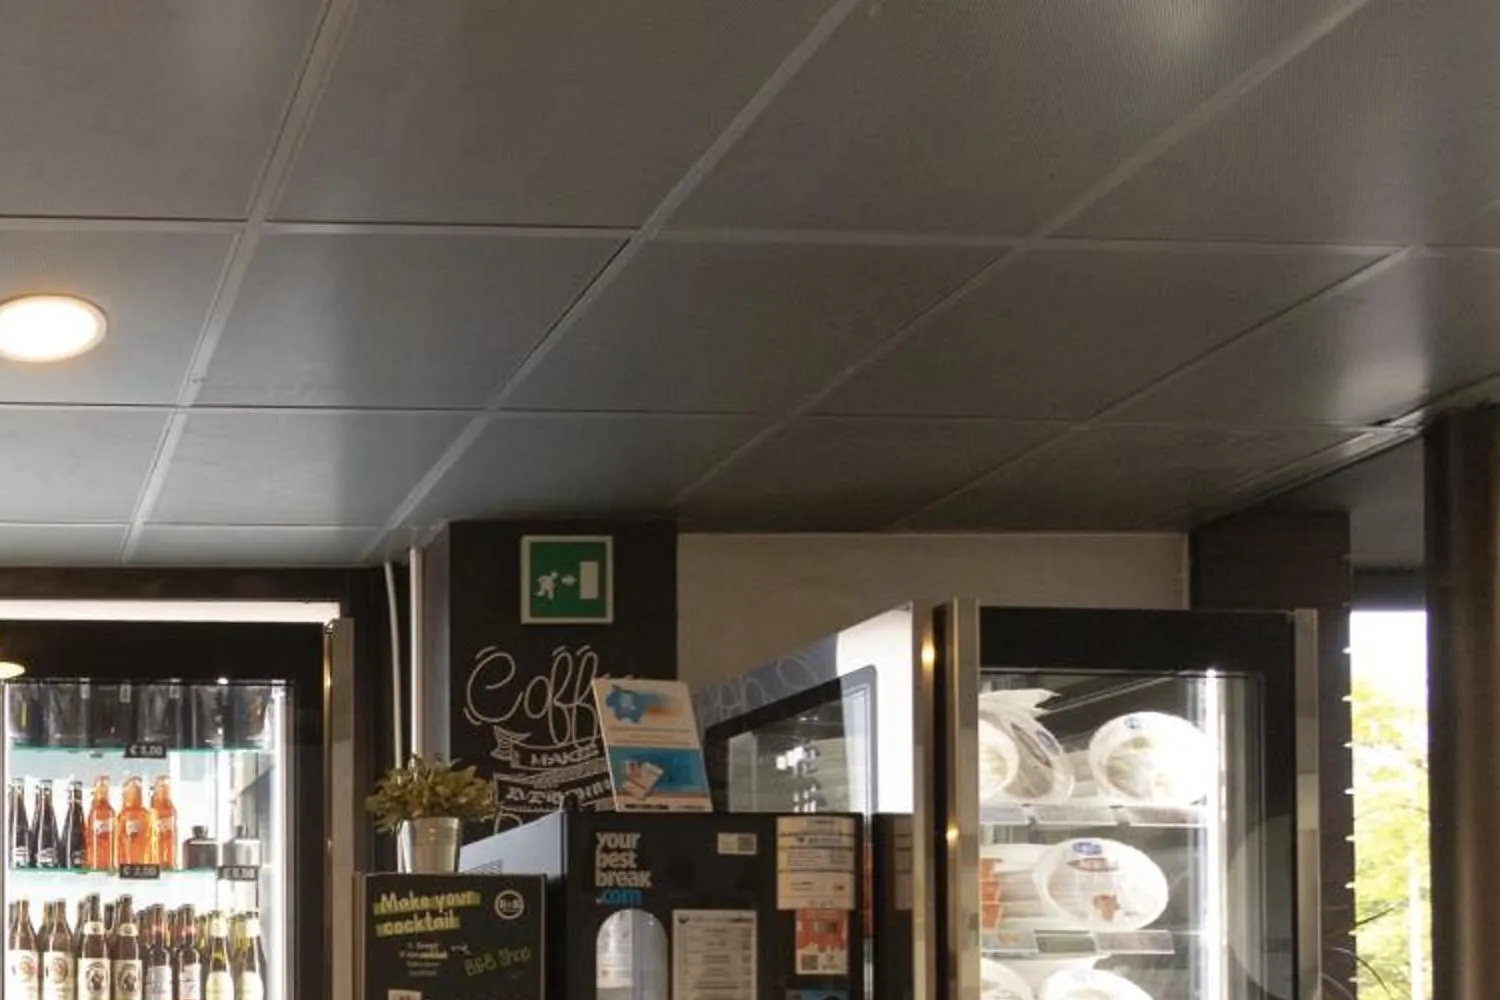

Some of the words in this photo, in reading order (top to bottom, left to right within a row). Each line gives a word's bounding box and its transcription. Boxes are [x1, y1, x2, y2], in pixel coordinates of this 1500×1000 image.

[596, 831, 641, 851] your
[596, 850, 637, 869] best
[596, 868, 652, 887] break
[380, 891, 430, 911] Make
[434, 891, 476, 915] your
[596, 887, 642, 905] .com
[384, 911, 457, 936] cocktail
